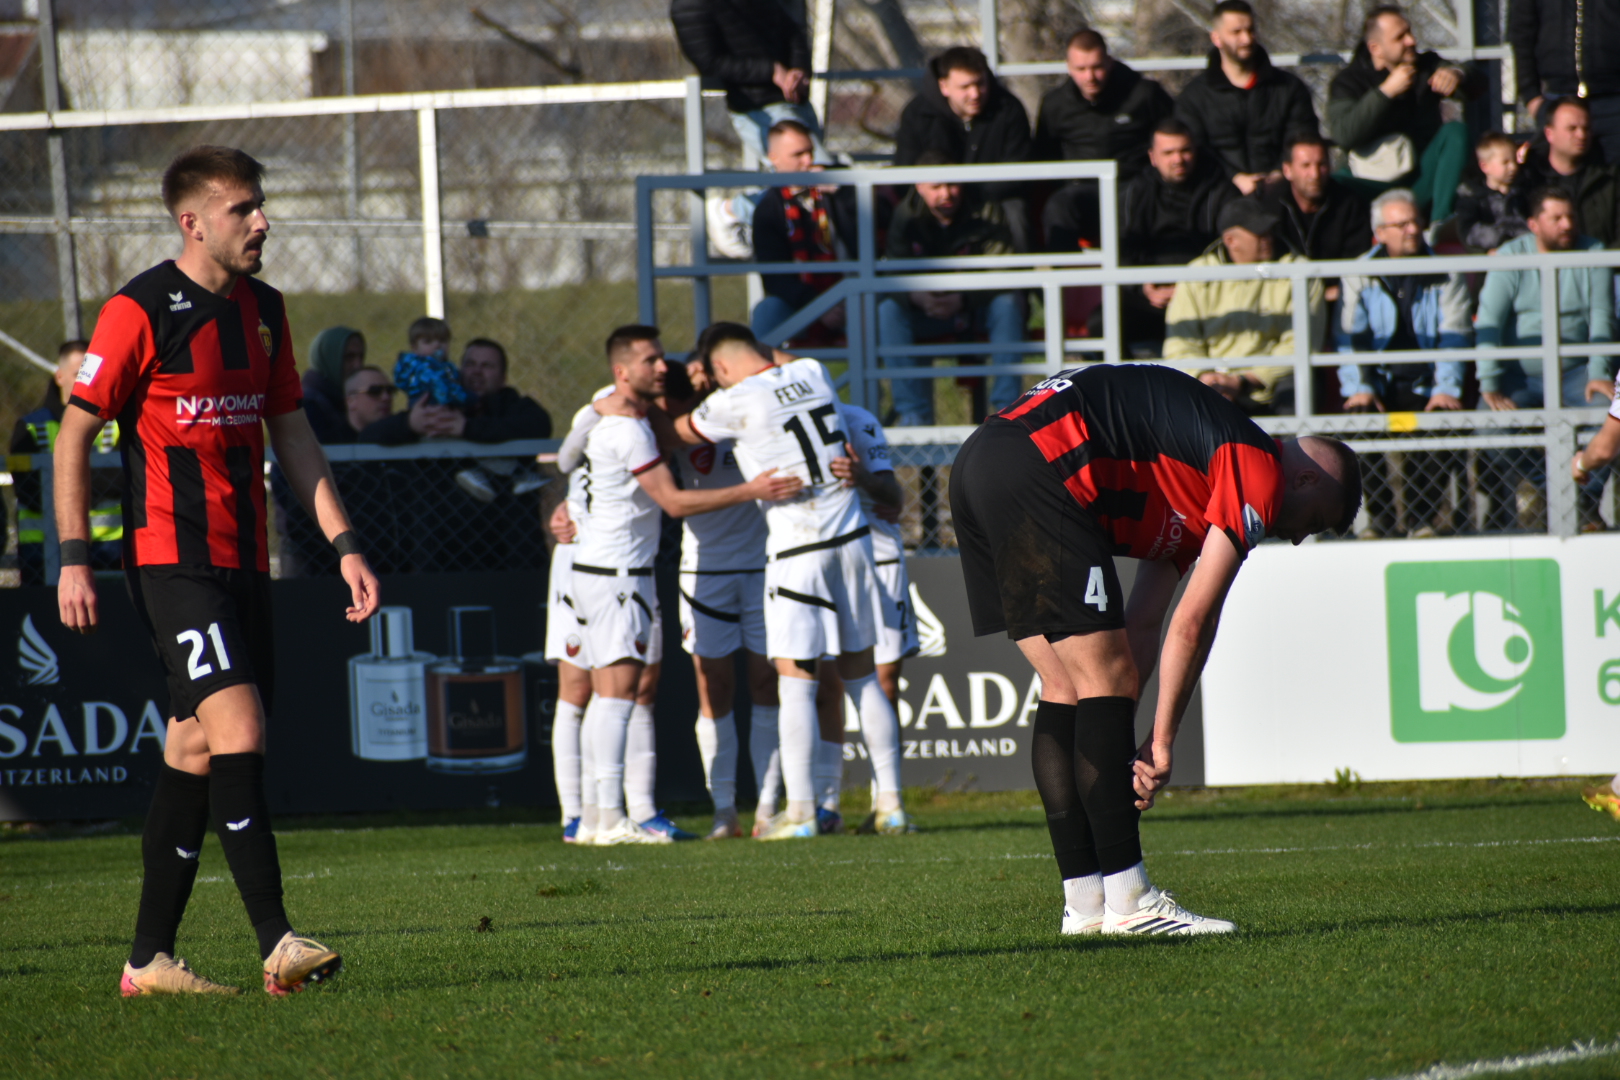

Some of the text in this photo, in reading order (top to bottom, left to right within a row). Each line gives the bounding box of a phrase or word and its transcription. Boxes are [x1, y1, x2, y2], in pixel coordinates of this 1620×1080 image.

[170, 301, 192, 312] erima
[212, 414, 257, 426] MACEDONIA
[783, 403, 849, 485] 15
[1084, 566, 1109, 612] 4
[176, 622, 231, 681] 21
[370, 701, 421, 717] Gisada
